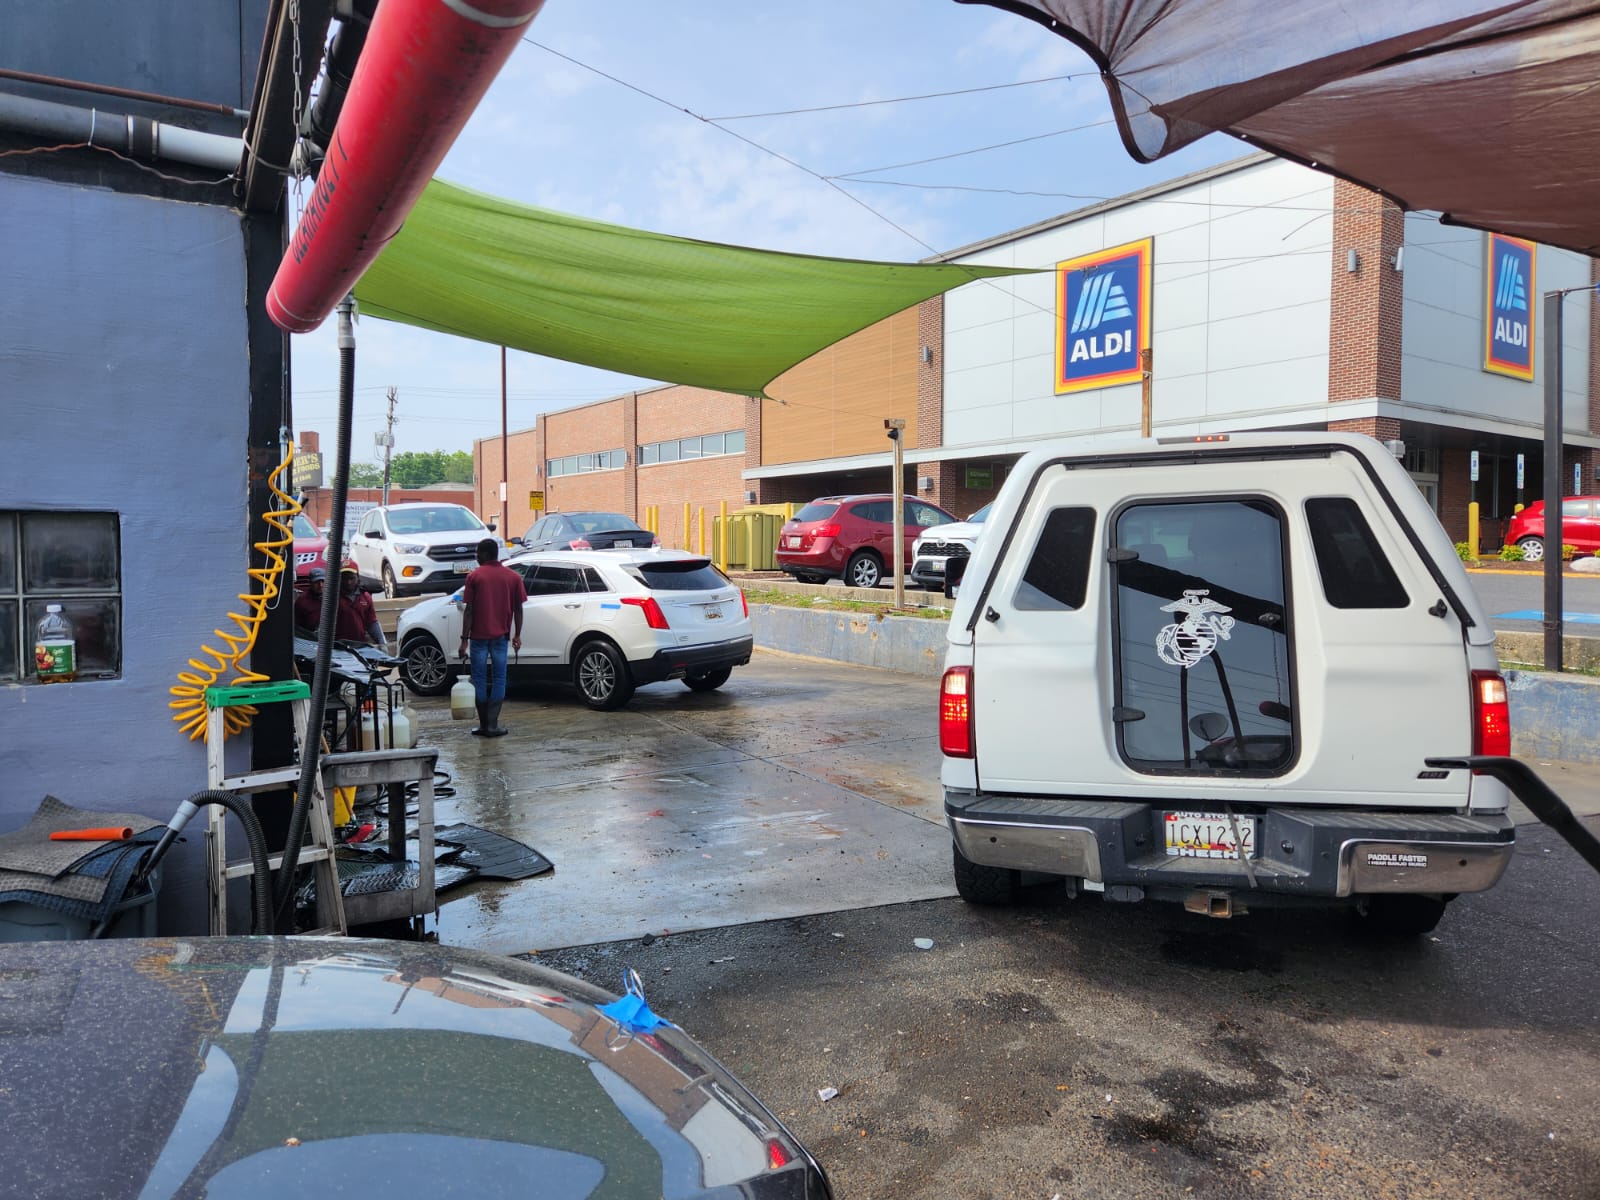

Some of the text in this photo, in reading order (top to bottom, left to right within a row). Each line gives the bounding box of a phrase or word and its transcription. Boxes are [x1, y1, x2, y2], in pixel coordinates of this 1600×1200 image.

[1494, 316, 1527, 348] ALDI
[1070, 329, 1132, 363] ALDI
[1204, 812, 1245, 820] STOES
[1166, 847, 1254, 860] SHEEHY
[1368, 854, 1397, 862] PADDLE
